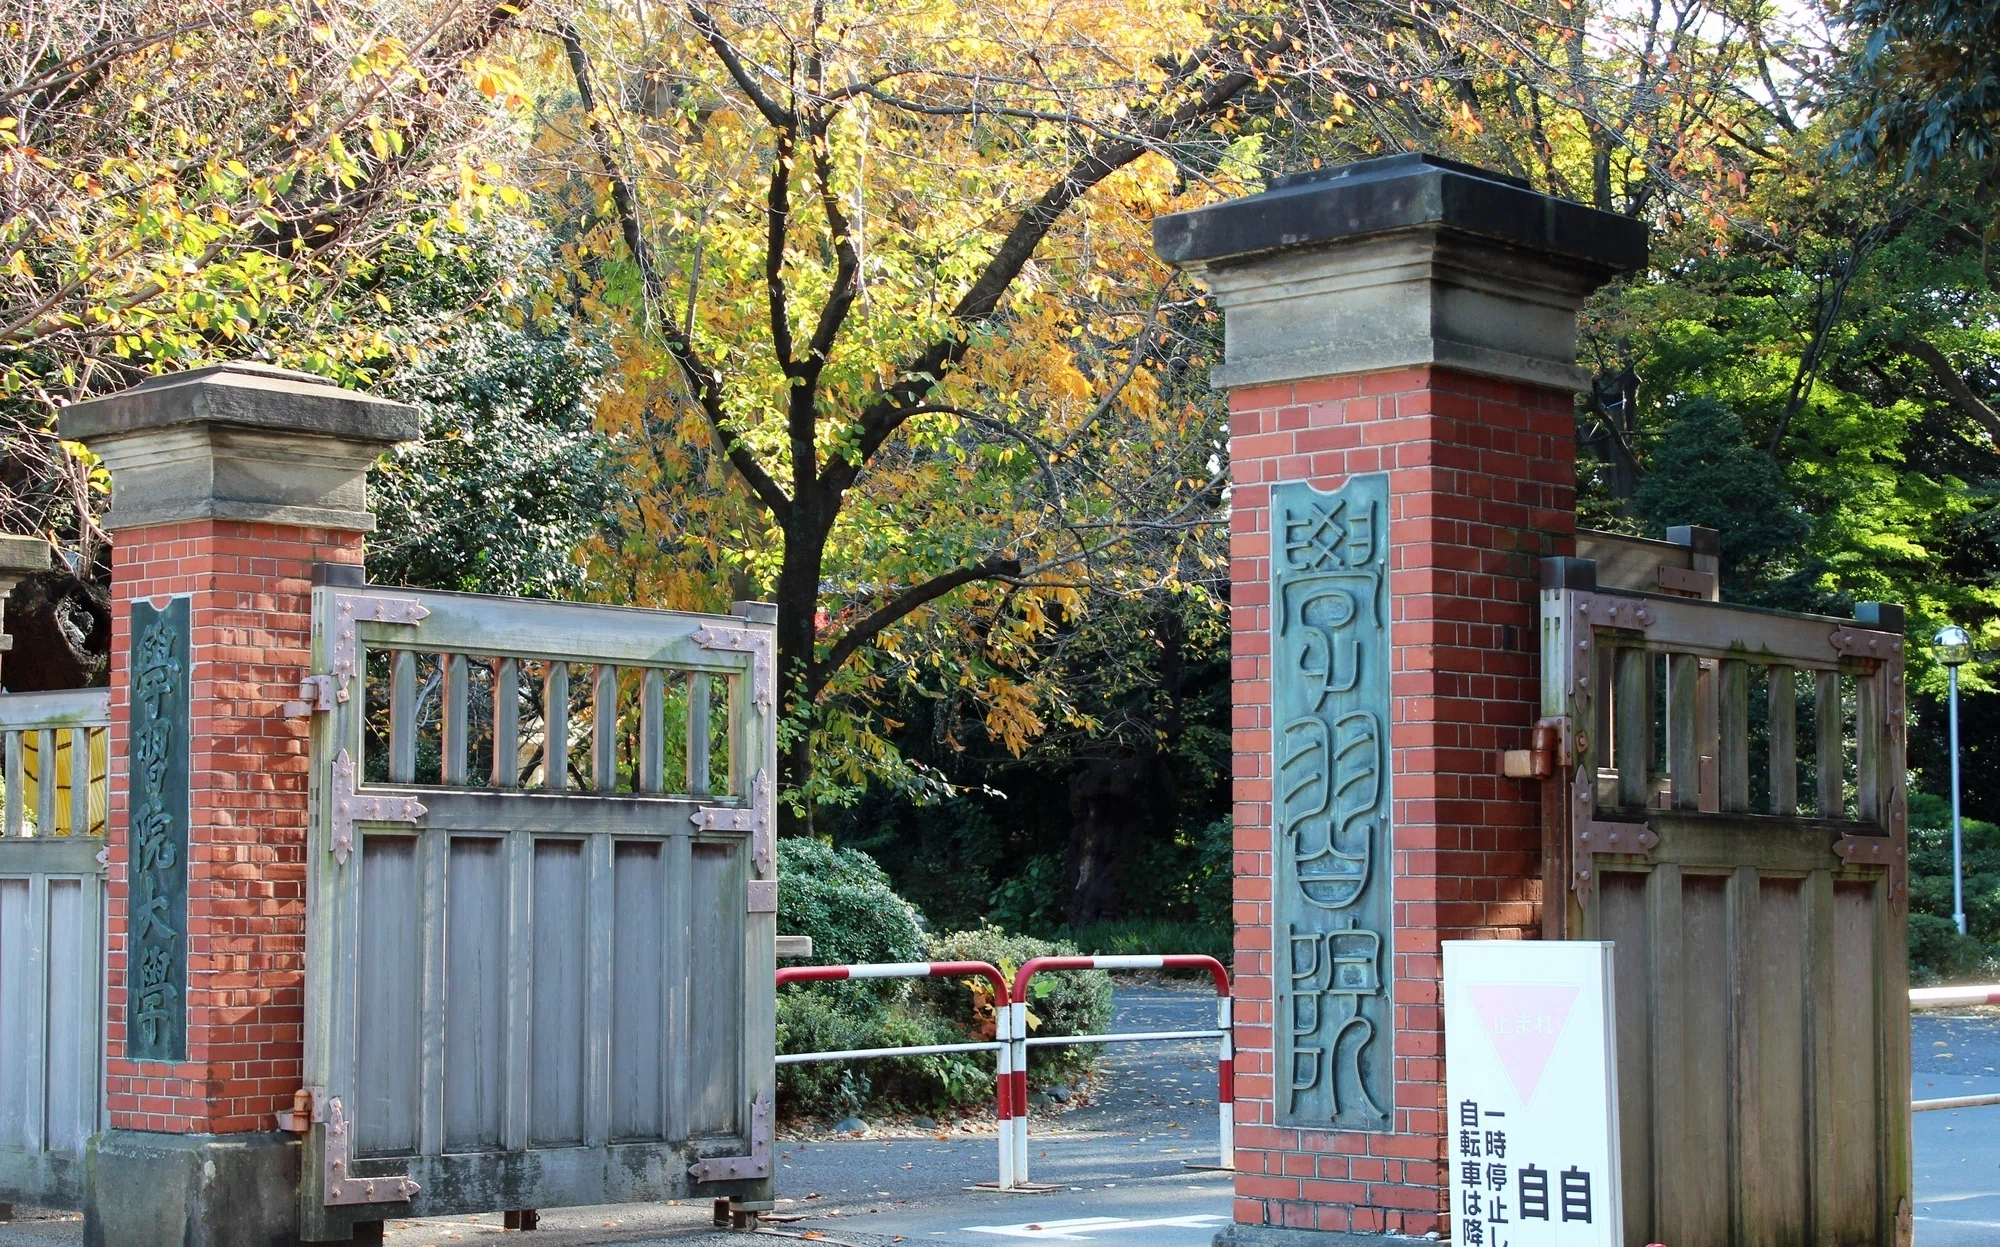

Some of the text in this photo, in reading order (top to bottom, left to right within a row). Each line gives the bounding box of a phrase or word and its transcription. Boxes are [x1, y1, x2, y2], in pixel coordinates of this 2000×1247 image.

[1493, 1012, 1554, 1034] 止まれ
[1518, 1162, 1549, 1221] 自
[1560, 1164, 1592, 1224] 自
